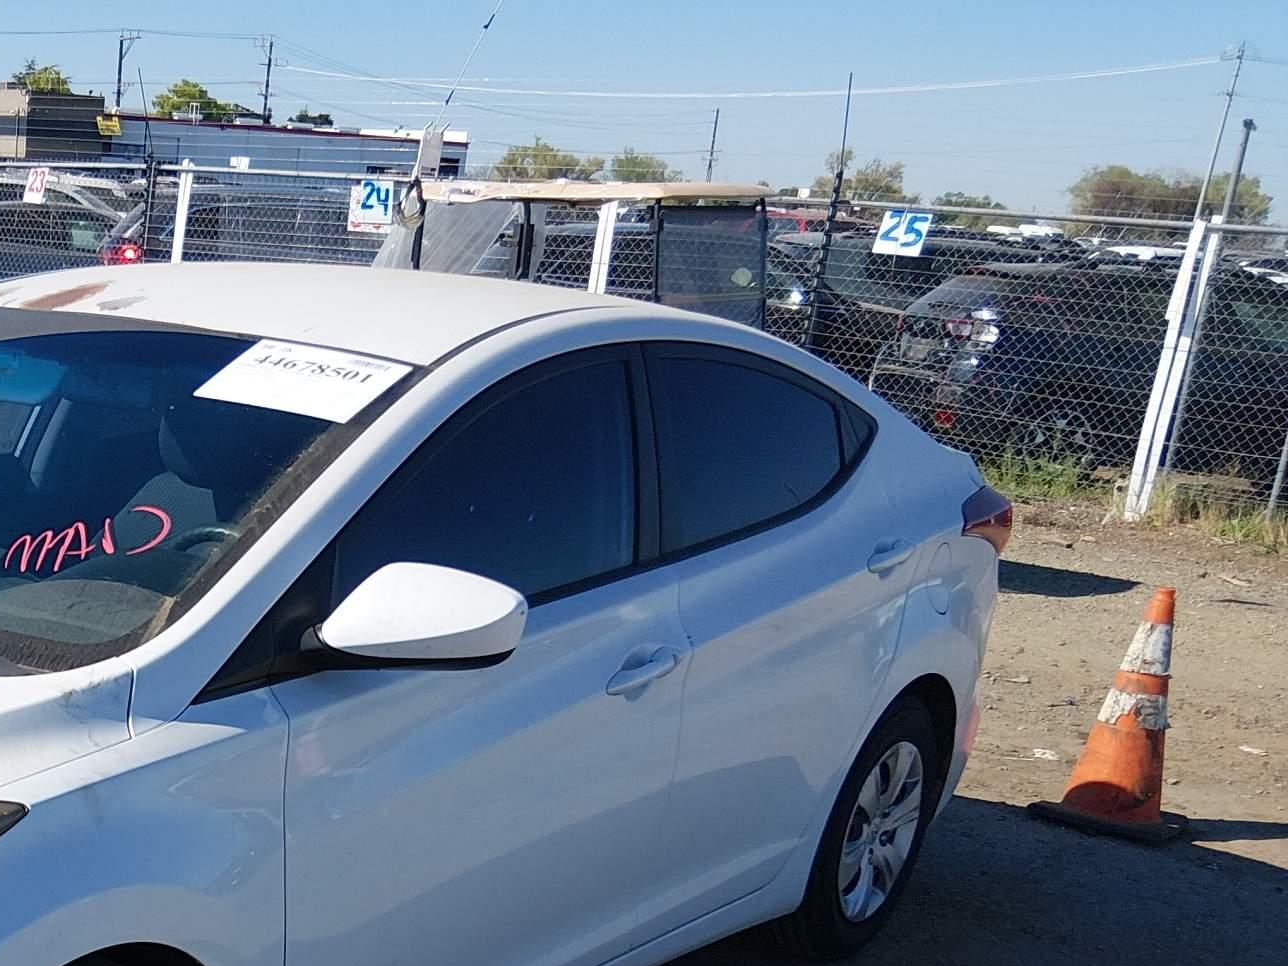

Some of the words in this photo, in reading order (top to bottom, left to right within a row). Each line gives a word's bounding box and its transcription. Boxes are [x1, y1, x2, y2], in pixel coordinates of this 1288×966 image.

[27, 170, 46, 193] 23
[360, 181, 390, 217] 24
[879, 210, 929, 247] 25
[254, 354, 373, 384] 44678501
